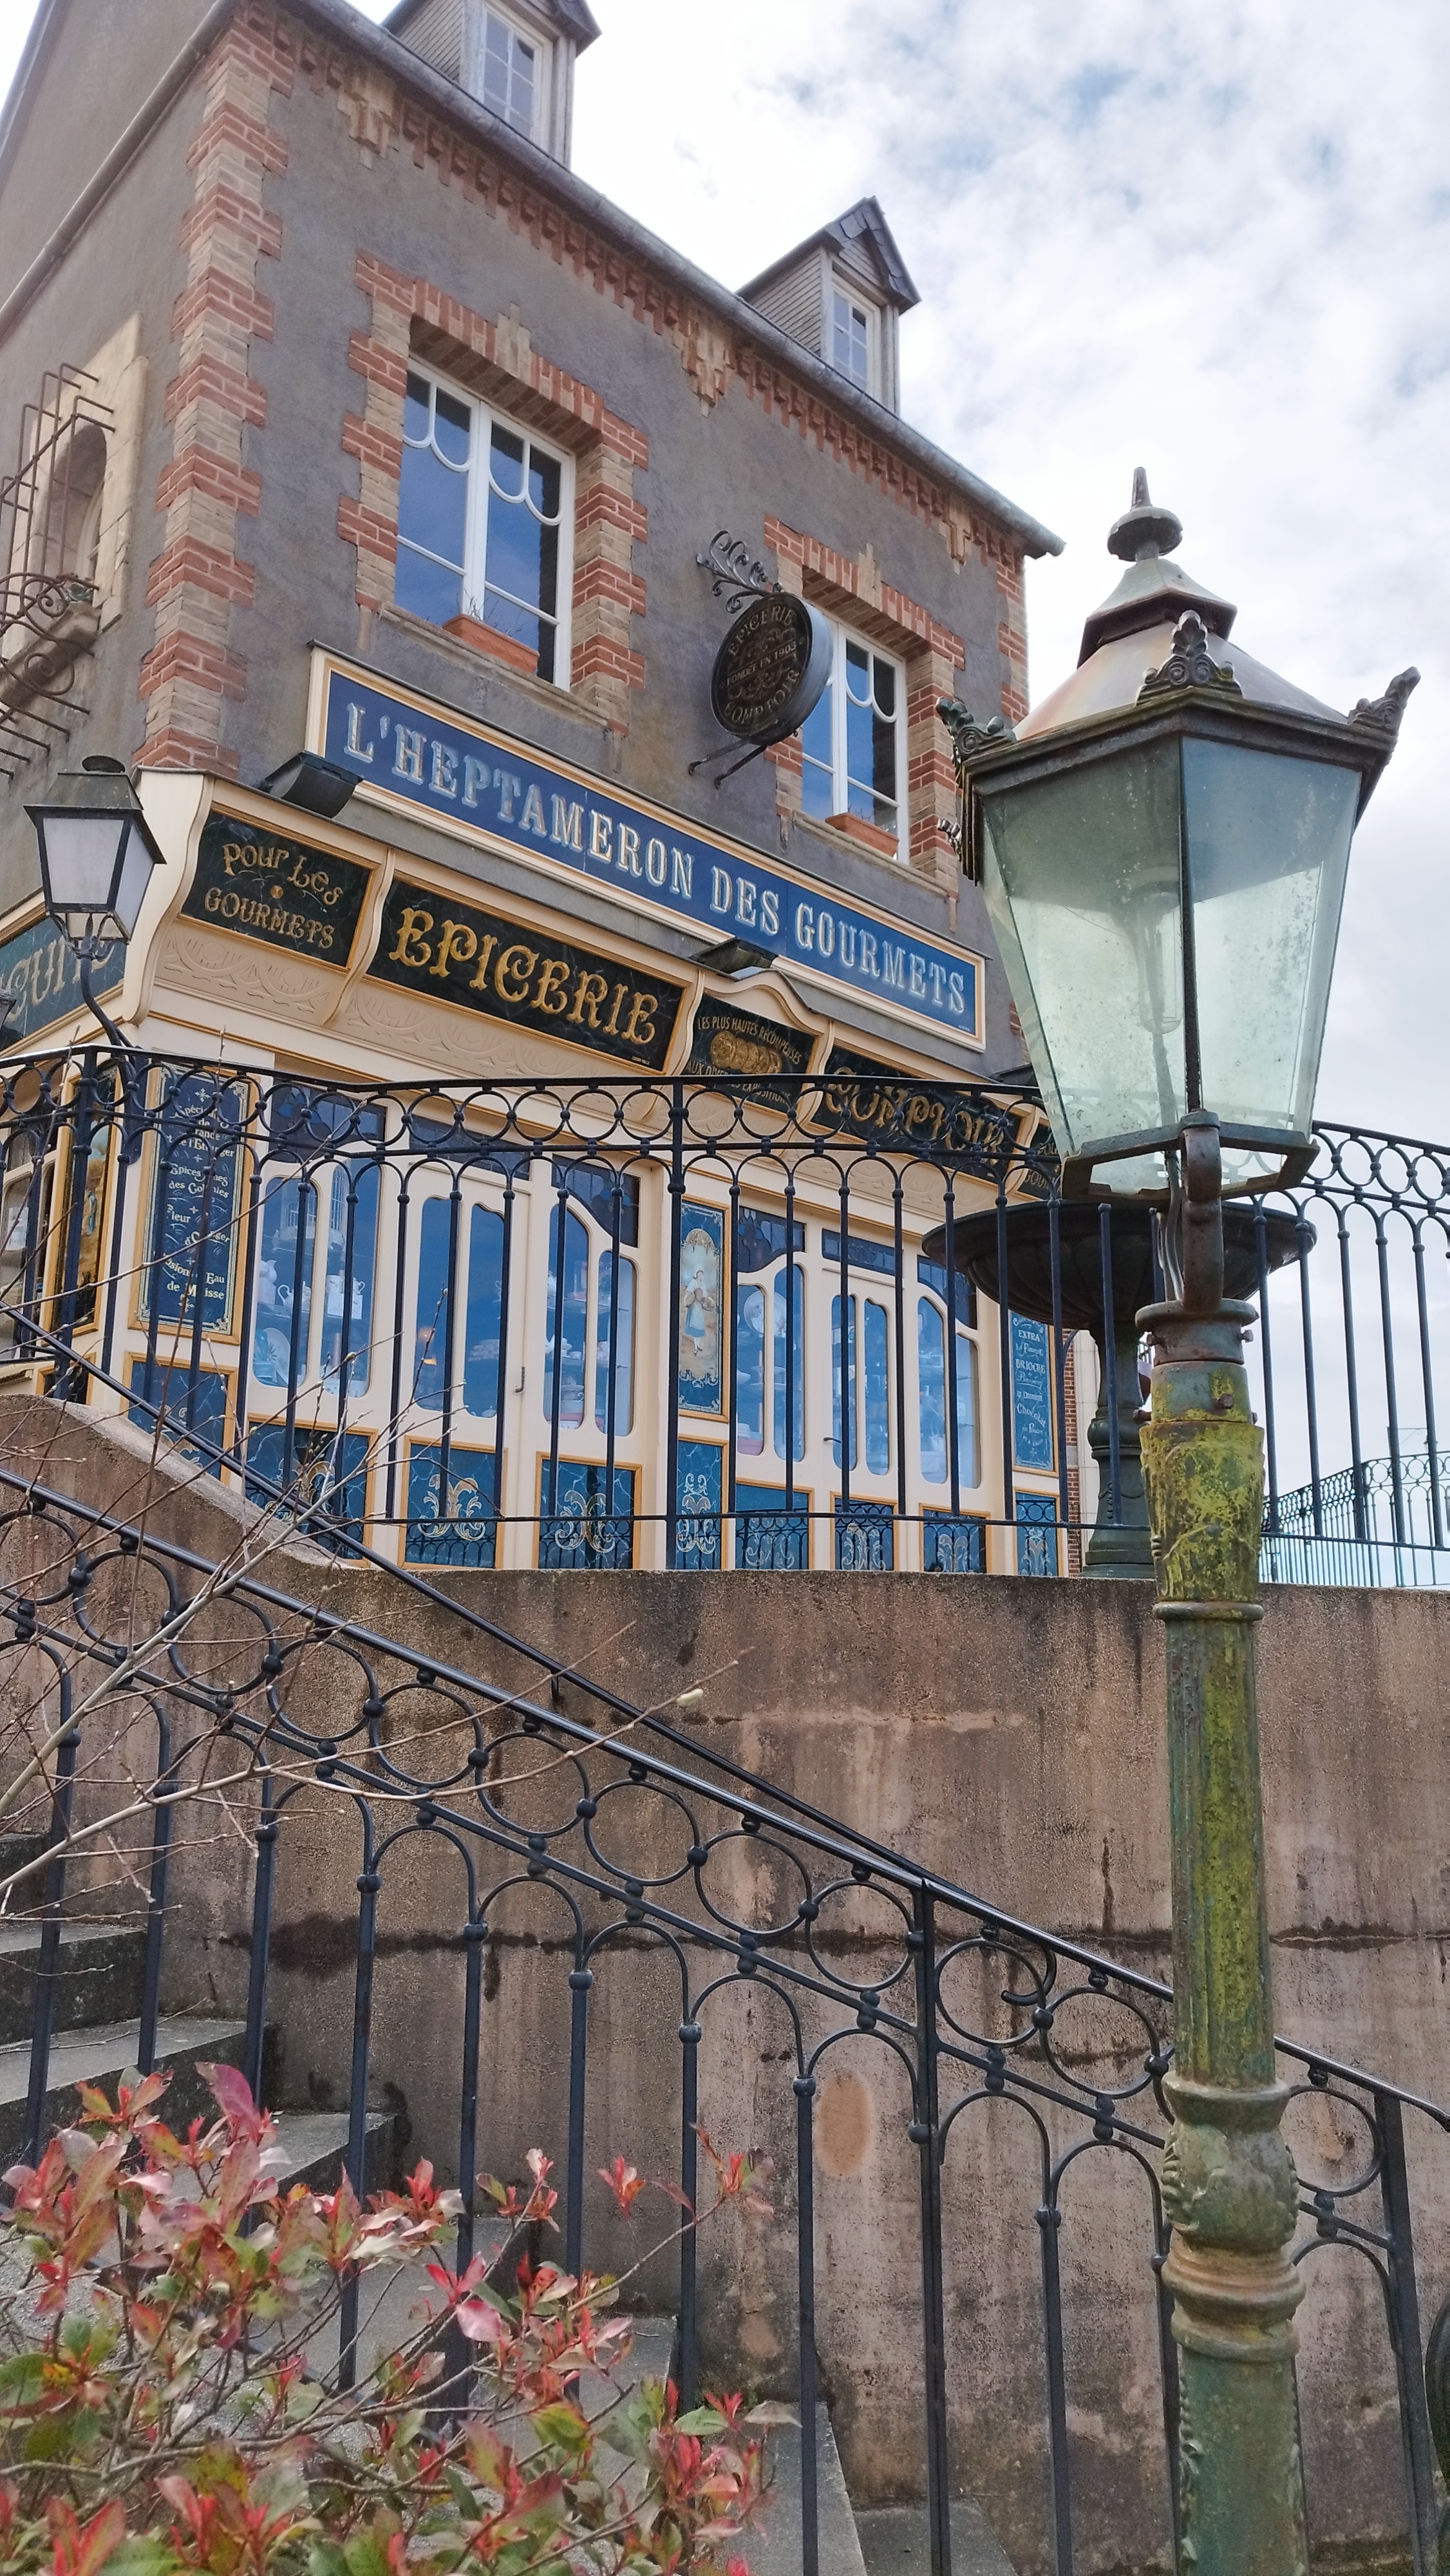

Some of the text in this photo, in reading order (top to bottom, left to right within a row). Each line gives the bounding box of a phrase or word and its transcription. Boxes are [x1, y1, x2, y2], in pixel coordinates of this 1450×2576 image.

[775, 641, 797, 660] 1903
[343, 702, 965, 1016] L'HEPTAMERON DES GOURMETS
[205, 886, 335, 949] GOURMETS
[388, 907, 659, 1045] EPICERIE
[697, 1016, 803, 1065] LES PLUS HAUTES RECOMPENSES
[169, 1180, 186, 1189] des
[167, 1281, 180, 1292] de
[205, 1272, 225, 1285] Eau
[1018, 1330, 1040, 1342] EXTRA
